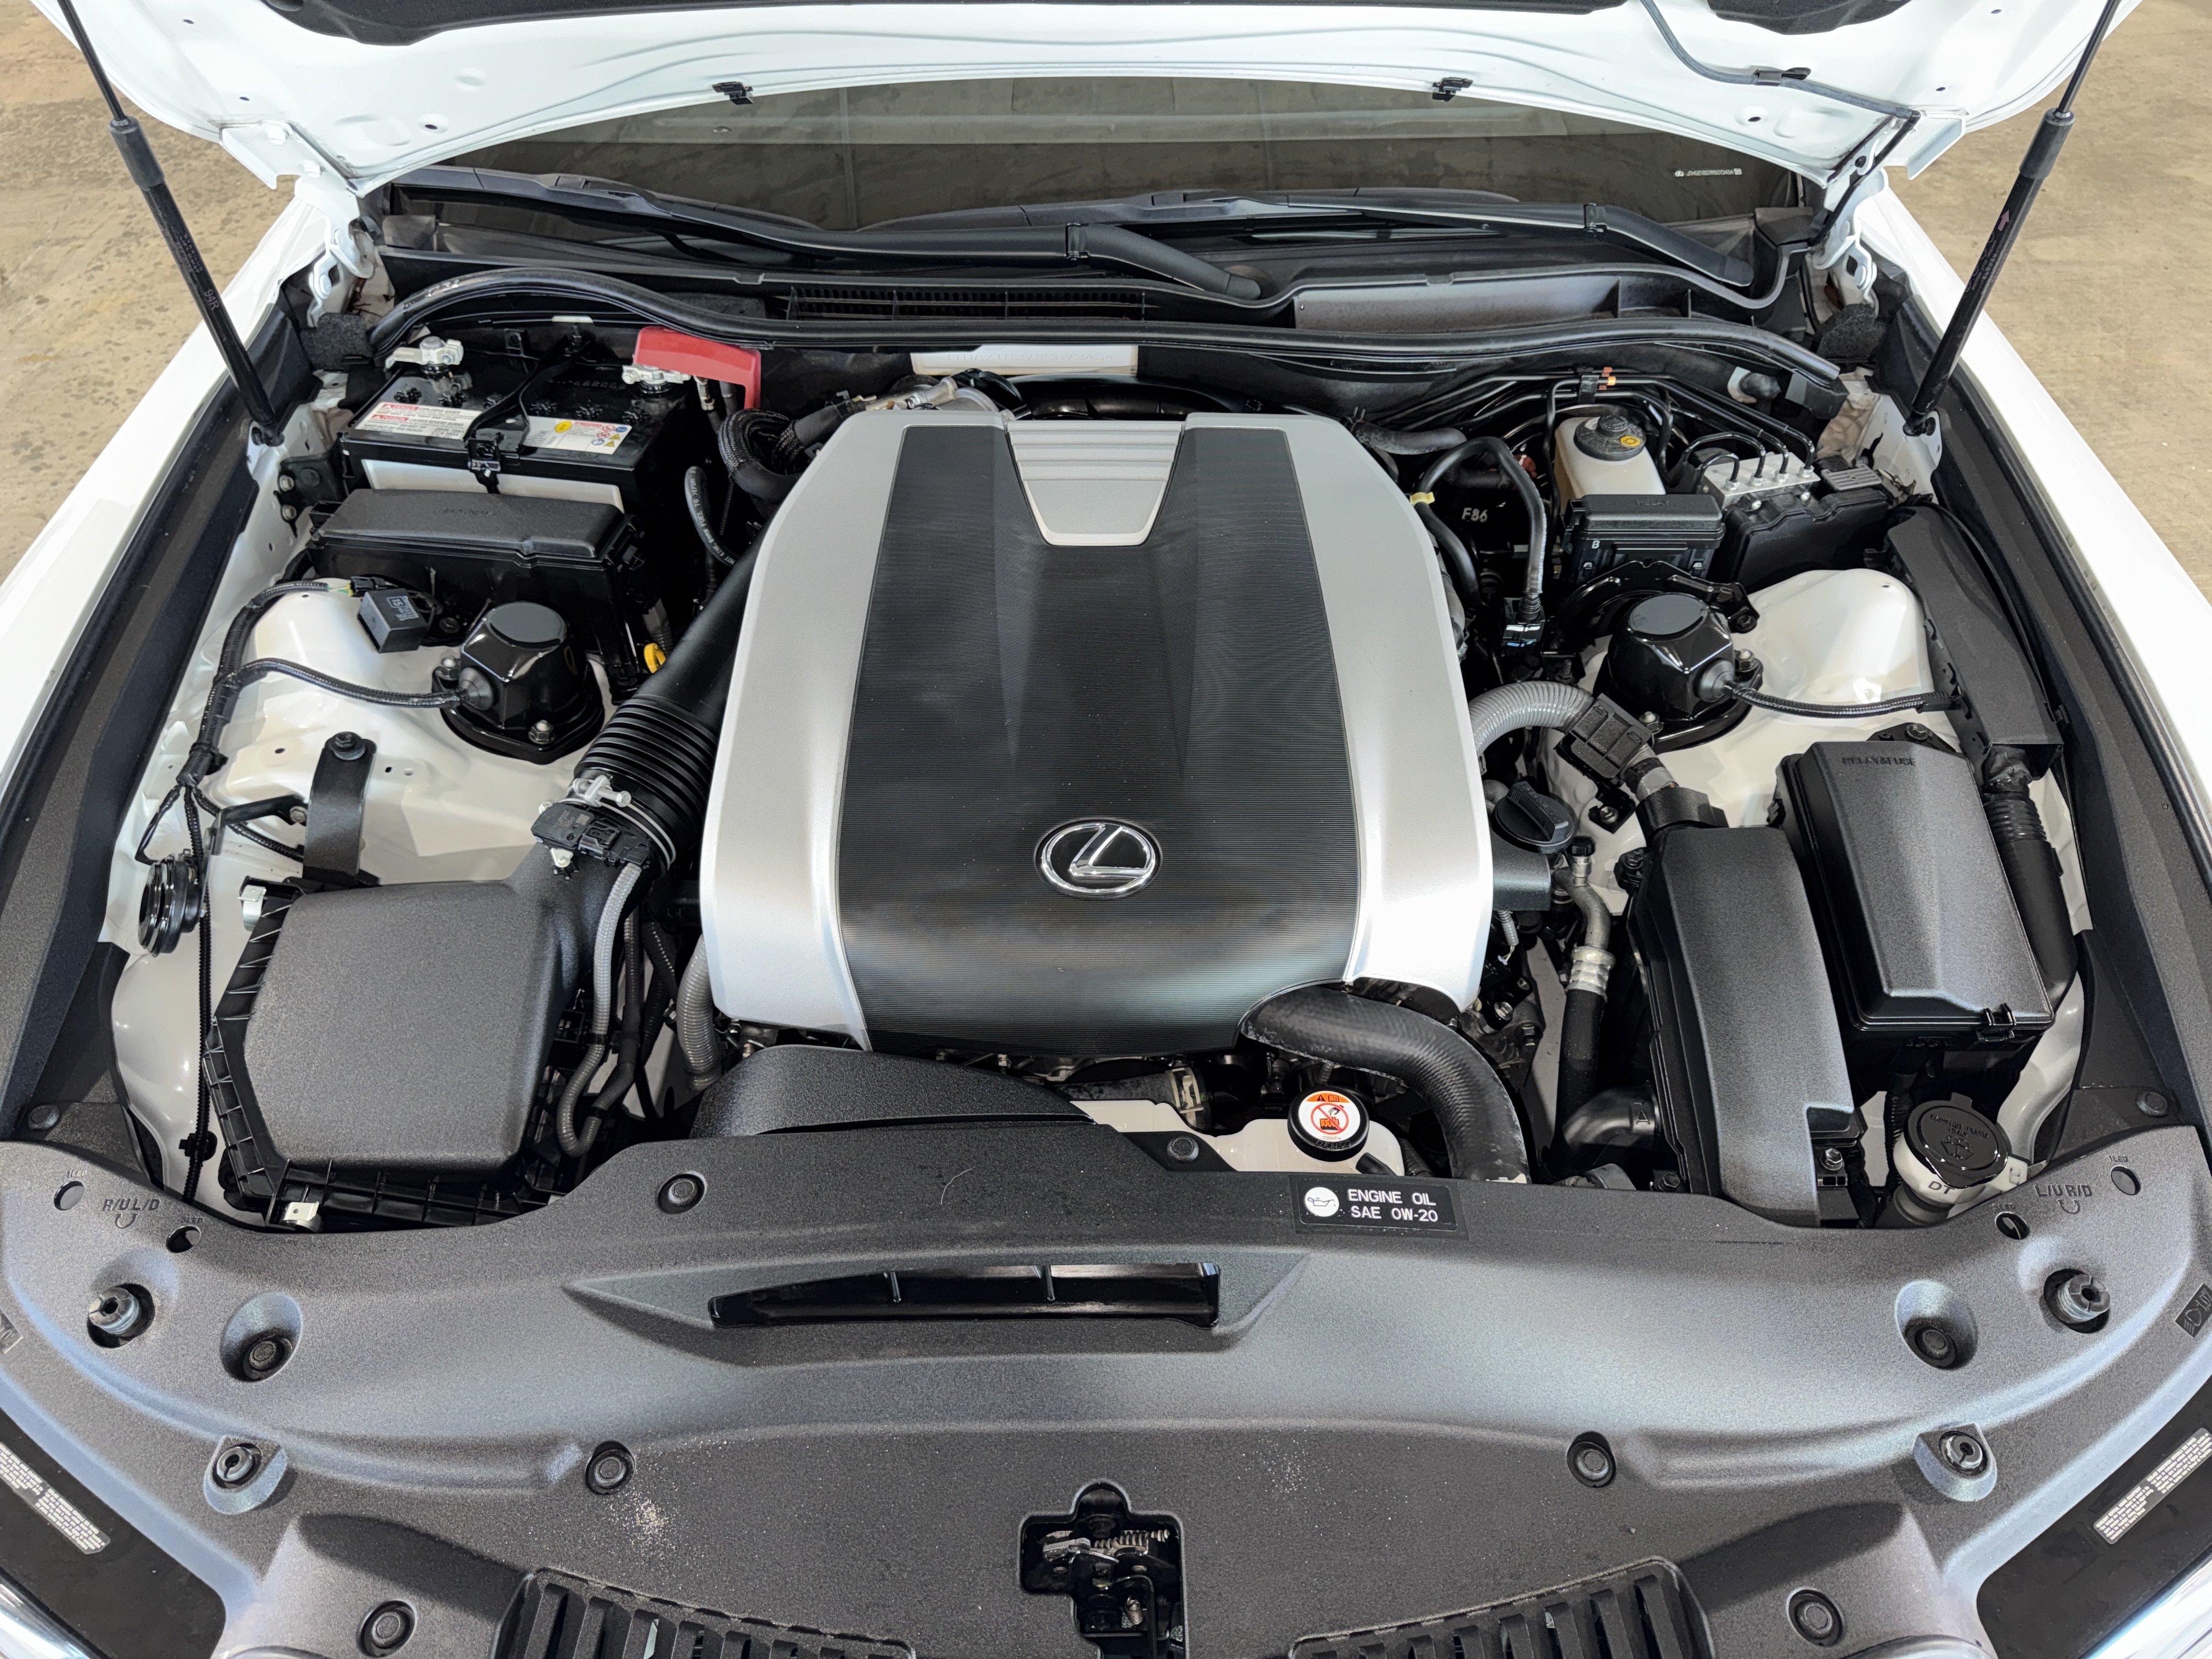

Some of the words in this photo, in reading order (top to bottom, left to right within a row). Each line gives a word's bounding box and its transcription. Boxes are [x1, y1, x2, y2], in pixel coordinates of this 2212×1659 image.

[204, 289, 219, 310] 94R
[1462, 507, 1488, 522] F86
[1592, 540, 1600, 549] B
[1315, 1139, 1351, 1150] DENSO
[1928, 1181, 1955, 1194] DT
[1347, 1188, 1403, 1204] ENGINE
[1412, 1192, 1437, 1206] OIL
[1350, 1205, 1382, 1220] SAE
[1391, 1207, 1438, 1222] 0W-20
